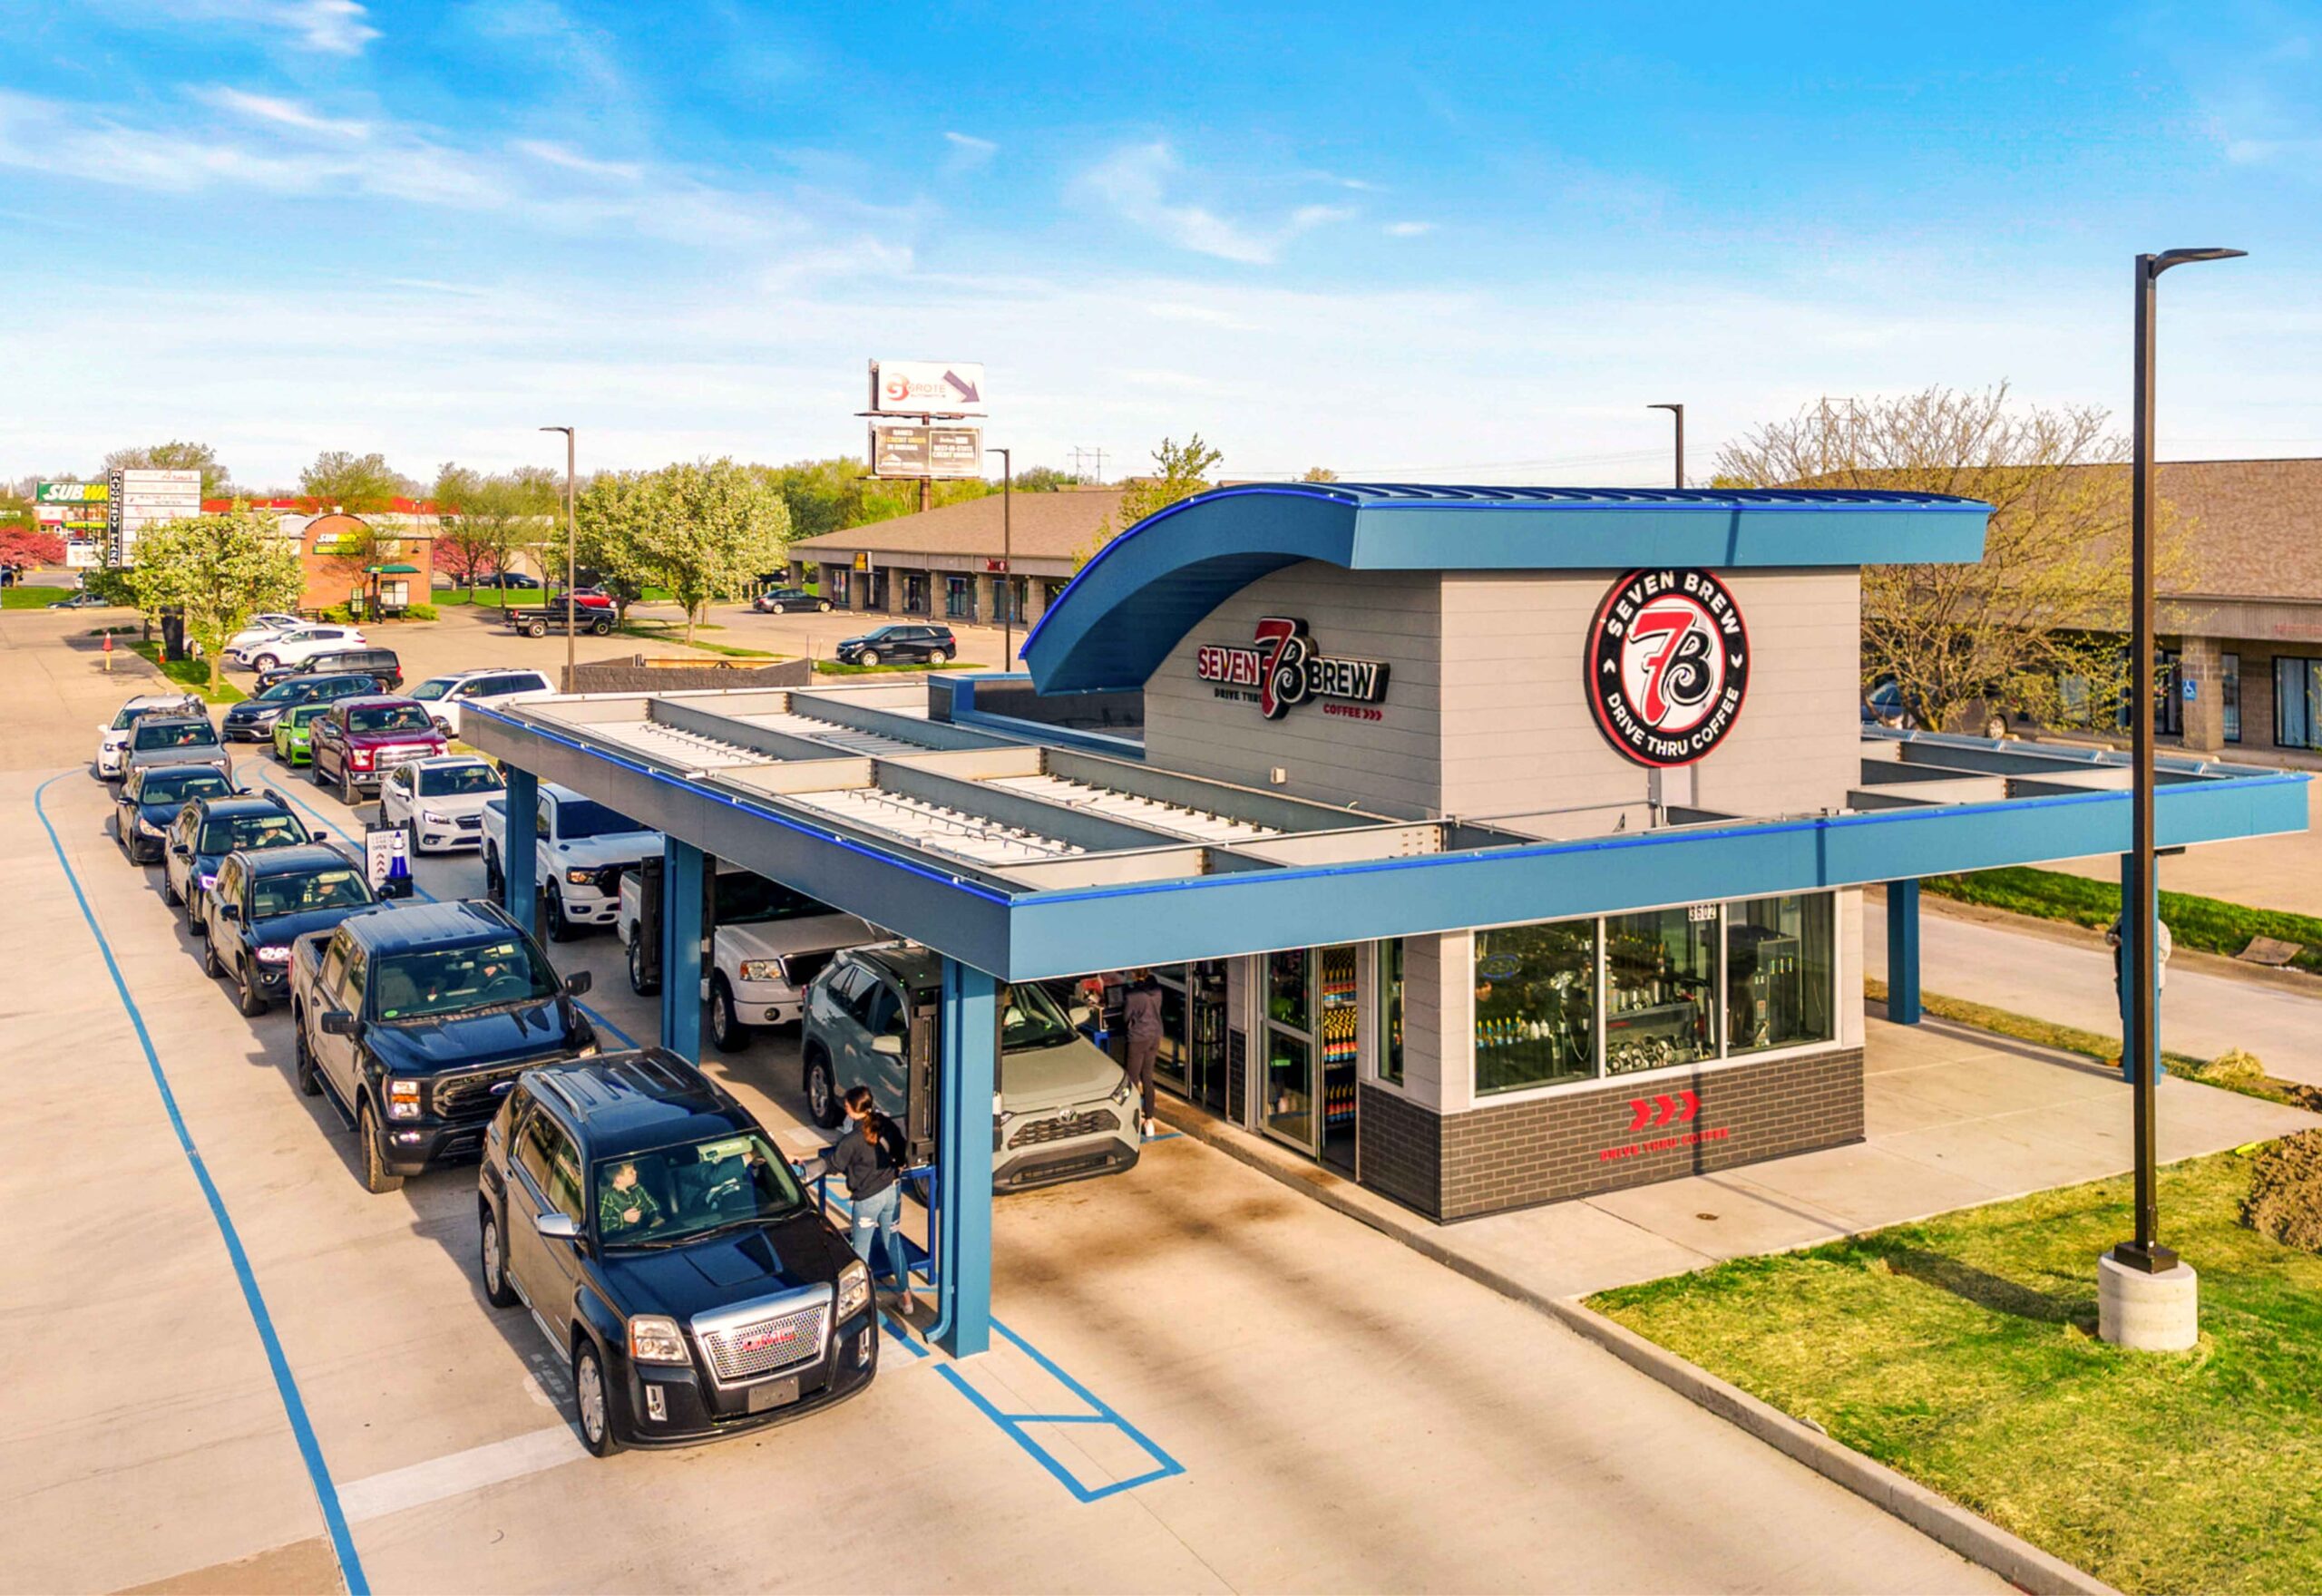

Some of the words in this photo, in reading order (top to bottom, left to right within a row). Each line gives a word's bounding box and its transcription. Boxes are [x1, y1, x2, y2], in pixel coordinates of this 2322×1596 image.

[43, 484, 109, 501] SUBWA
[110, 534, 119, 564] PLAZA
[1608, 570, 1674, 637] SEVEN
[1684, 572, 1741, 635] BREW
[1197, 646, 1260, 686] SEVEN
[1309, 657, 1378, 701] BREW
[1214, 687, 1240, 701] DRIVE
[1323, 703, 1361, 718] COFFEE
[1607, 692, 1644, 745] DRIVE
[1647, 735, 1688, 756] THRU
[1692, 688, 1740, 749] COFFEE
[1689, 904, 1715, 920] 3602
[1599, 1143, 1639, 1162] DRIVE
[1643, 1136, 1678, 1153] THRU
[1681, 1127, 1729, 1146] COFFEE
[742, 1326, 796, 1350] GMC
